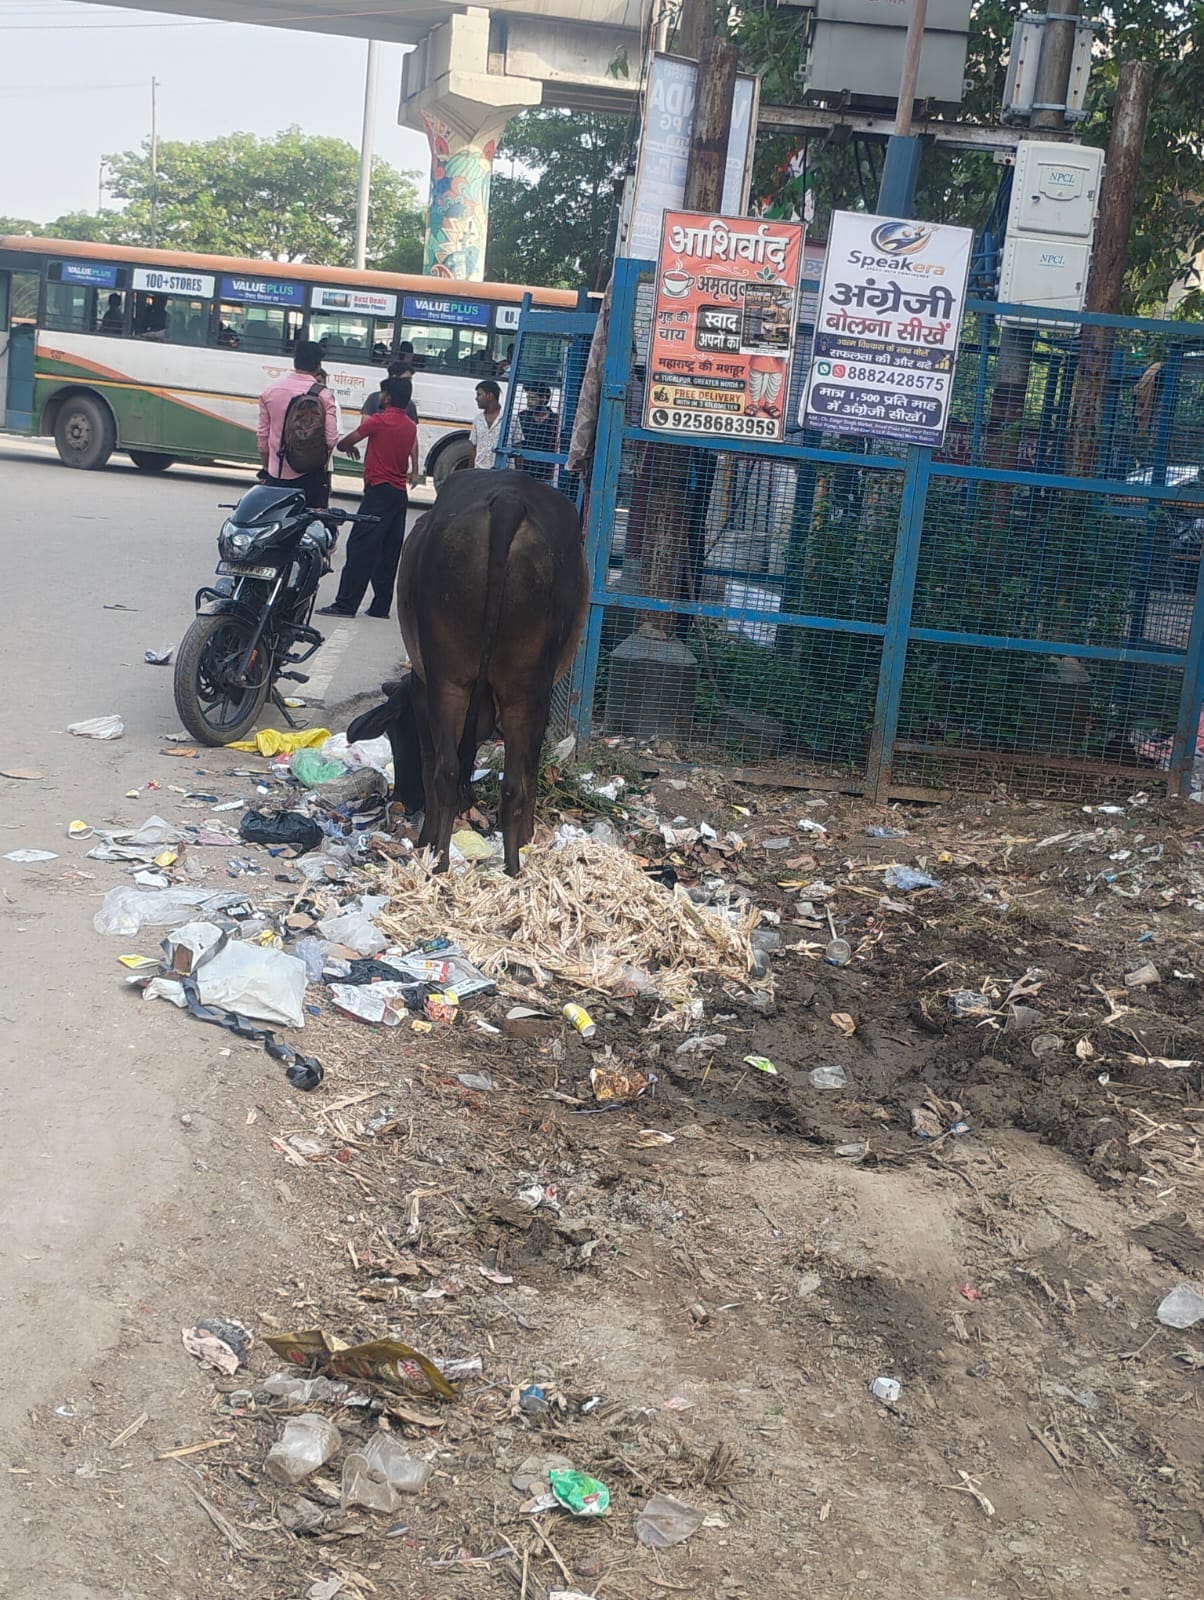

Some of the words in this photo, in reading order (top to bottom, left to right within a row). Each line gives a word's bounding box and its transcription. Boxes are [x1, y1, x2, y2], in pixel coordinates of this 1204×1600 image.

[1049, 172, 1075, 184] NPCL
[668, 219, 789, 272] आशिर्वाद
[847, 250, 945, 277] Speakera
[1040, 253, 1065, 265] NPCL
[145, 273, 202, 292] 100+STORES
[828, 278, 957, 320] अंग्रेजी
[676, 310, 689, 324] की
[704, 311, 739, 333] स्वाद
[658, 328, 687, 342] चाय
[825, 308, 892, 338] बोलना
[897, 317, 951, 346] सीखें
[698, 330, 726, 349] अपनों
[726, 335, 740, 350] का
[829, 348, 873, 362] सफलता
[875, 353, 891, 365] की
[658, 358, 695, 373] महाराष्ट्र
[698, 360, 713, 372] की
[716, 363, 746, 377] मशहूर
[334, 371, 366, 389] परिवहन
[847, 366, 945, 392] 8882428575
[674, 388, 697, 399] FREE
[698, 391, 741, 402] DELIVERY
[819, 386, 846, 399] मात्र
[849, 391, 880, 404] 1,500
[883, 393, 908, 407] प्रति
[911, 398, 938, 412] माह
[826, 399, 842, 412] में
[842, 402, 885, 417] अंग्रेजी
[672, 411, 776, 436] 9258683959
